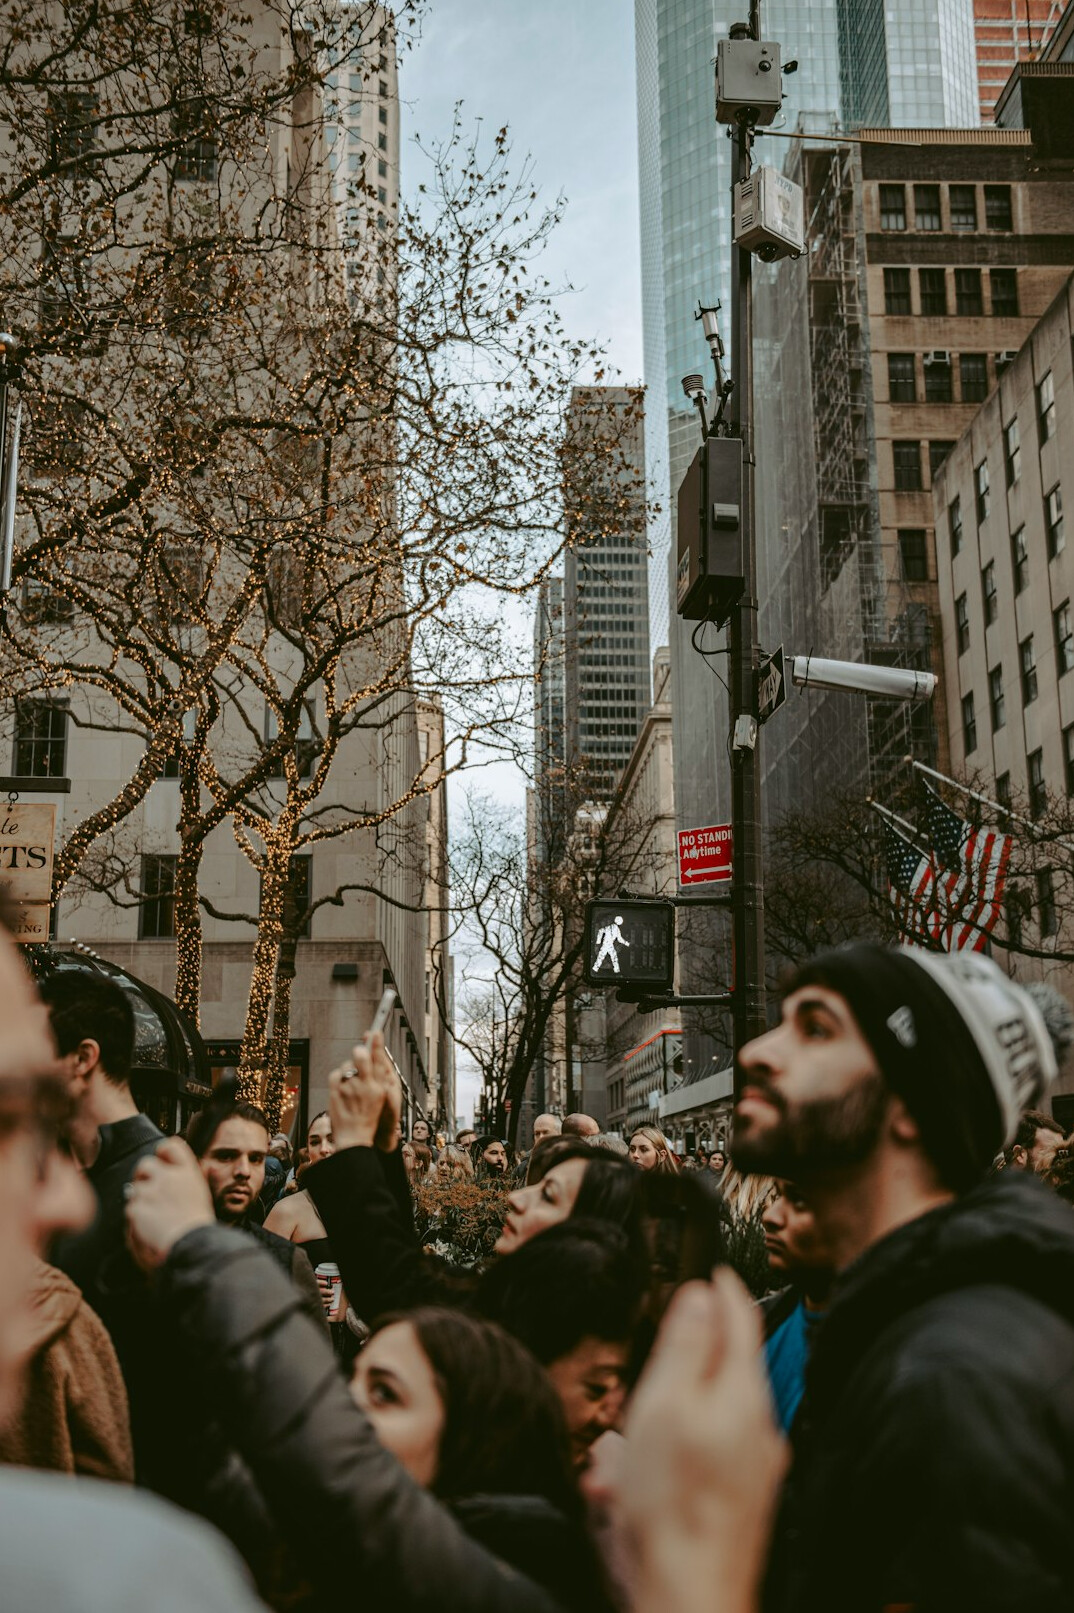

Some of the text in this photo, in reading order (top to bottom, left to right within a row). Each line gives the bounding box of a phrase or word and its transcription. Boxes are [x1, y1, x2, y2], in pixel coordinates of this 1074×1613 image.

[682, 830, 732, 847] NO STANDI
[0, 846, 46, 869] TS
[15, 924, 42, 934] ING
